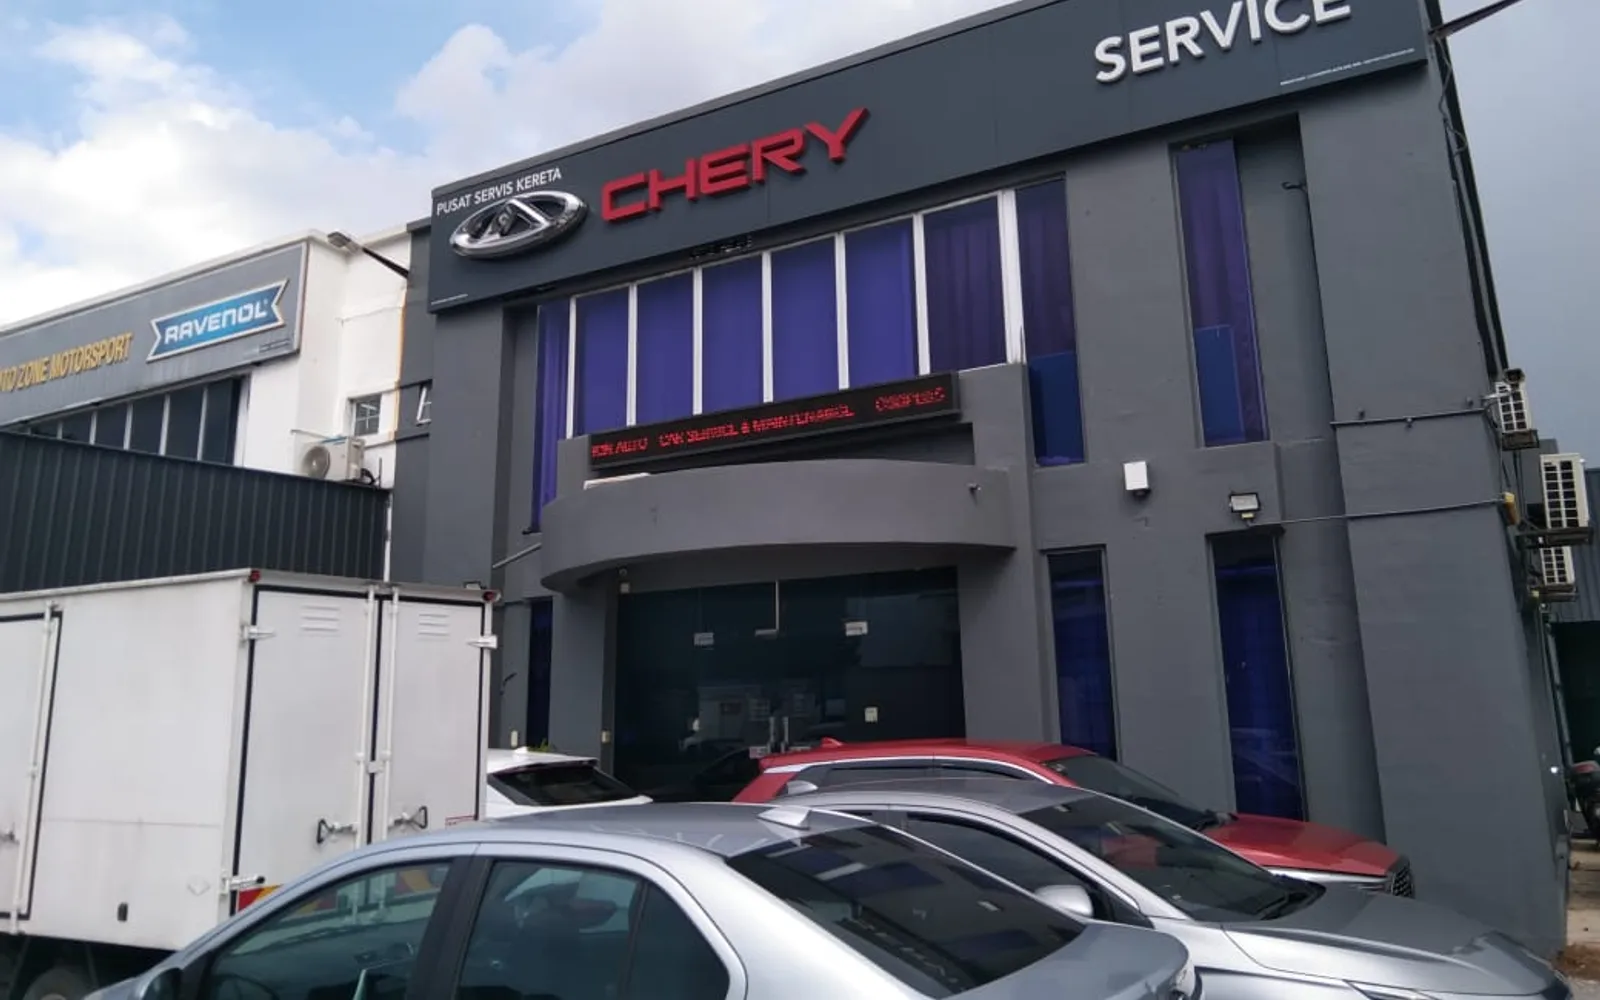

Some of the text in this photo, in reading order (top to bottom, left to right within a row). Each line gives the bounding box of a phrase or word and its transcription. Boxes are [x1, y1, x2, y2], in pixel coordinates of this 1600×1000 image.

[1094, 0, 1351, 84] SERVICE
[436, 167, 562, 216] PUSAT SERVIS KERETA
[602, 107, 868, 222] CHERY
[17, 357, 50, 390] ZONE
[50, 331, 134, 379] MOTORSPORT
